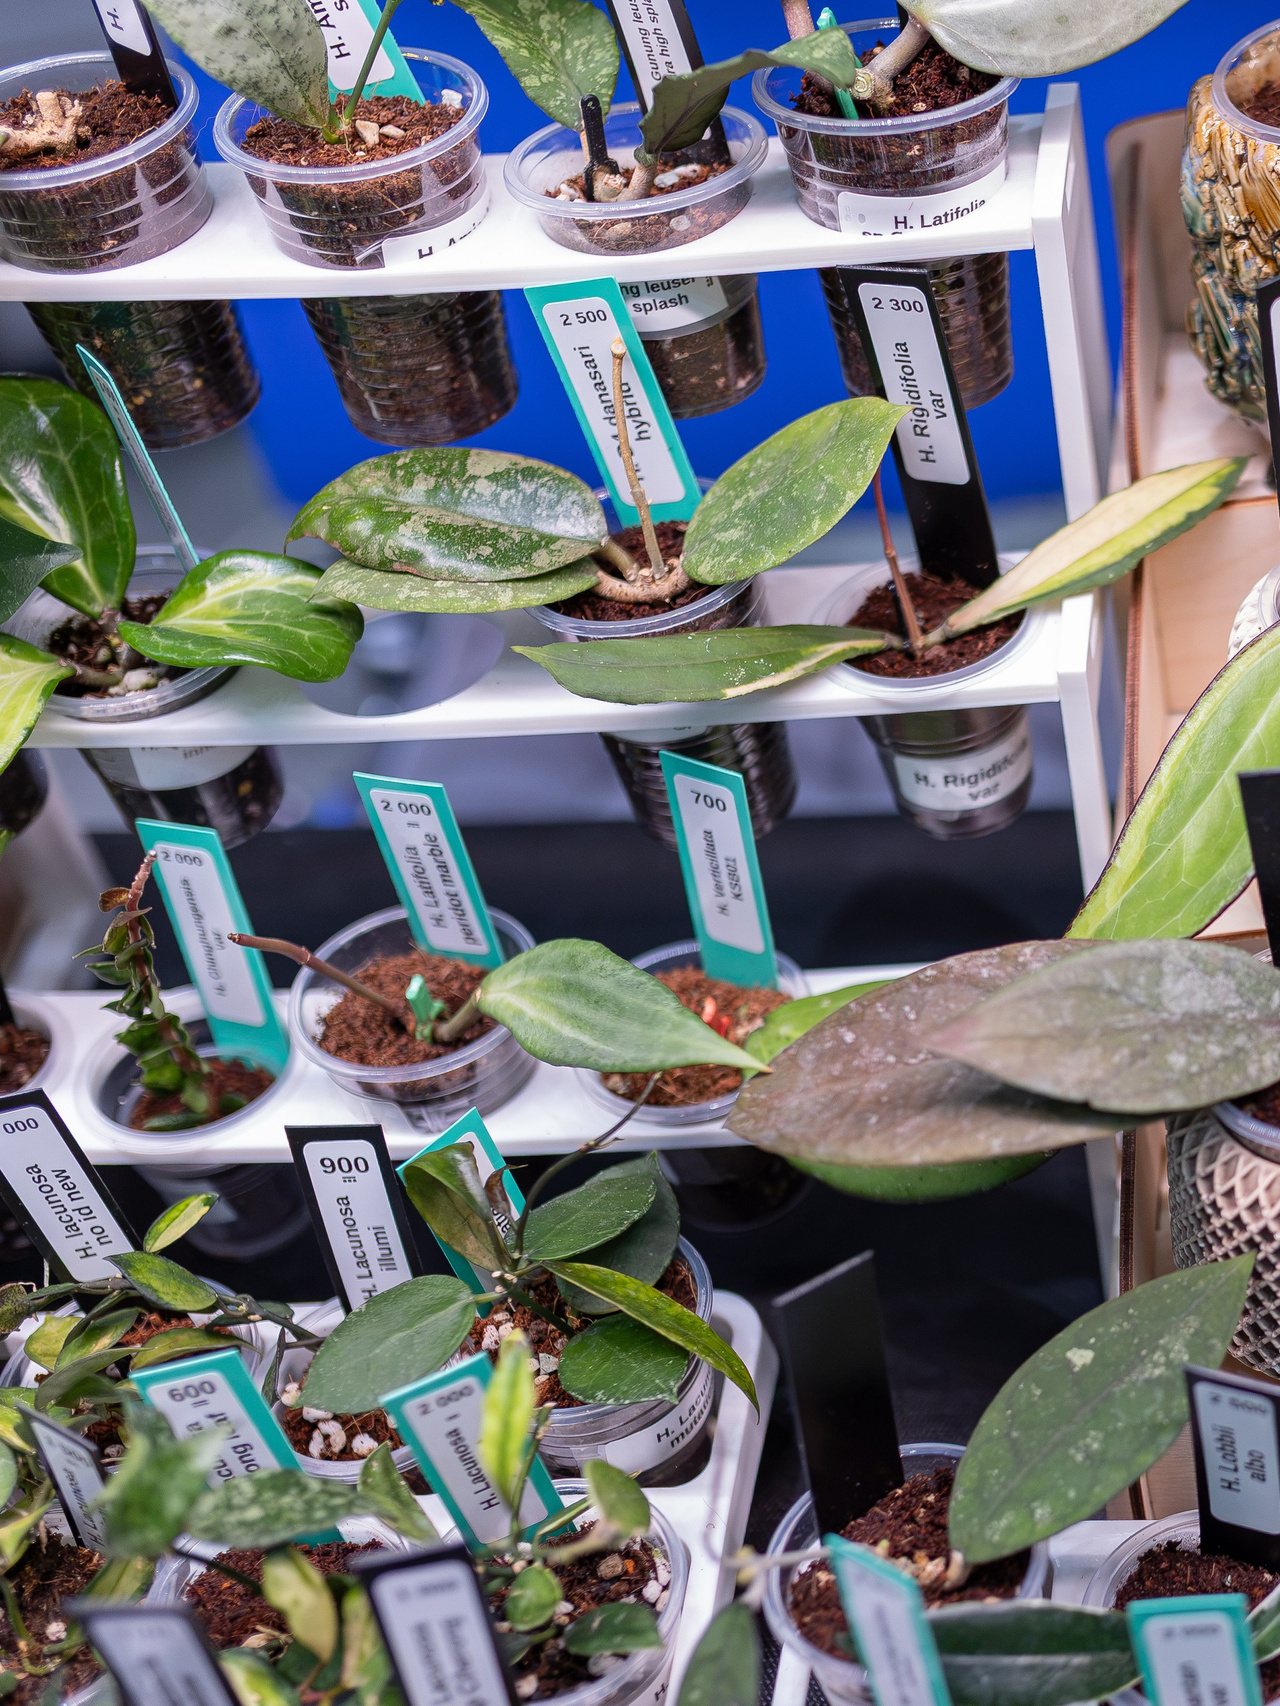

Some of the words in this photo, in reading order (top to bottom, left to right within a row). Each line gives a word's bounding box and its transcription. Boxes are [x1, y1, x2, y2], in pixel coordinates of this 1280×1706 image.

[652, 26, 671, 57] high
[638, 27, 662, 81] Gunung
[894, 215, 914, 229] H.
[632, 293, 690, 315] splash
[872, 297, 885, 310] 2
[890, 299, 924, 313] 300
[559, 313, 573, 326] 2
[575, 309, 608, 324] 500
[895, 341, 930, 438] Rigidifolia
[935, 390, 948, 419] var
[920, 444, 936, 464] H.
[380, 800, 393, 812] 2
[398, 802, 431, 816] 000
[690, 790, 727, 813] 700
[161, 851, 171, 862] 2
[175, 853, 203, 867] 000
[424, 832, 455, 888] marble
[703, 829, 726, 899] Verticillata
[404, 845, 440, 909] Latifolia
[444, 891, 484, 947] peridot
[2, 1117, 39, 1135] 000
[319, 1156, 369, 1174] 900
[51, 1168, 84, 1202] new
[25, 1163, 84, 1239] lacunosa
[72, 1205, 97, 1222] id
[90, 1224, 113, 1245] no
[336, 1195, 374, 1281] Lacunosa
[75, 1240, 98, 1260] H.
[167, 1381, 216, 1402] 600
[1212, 1424, 1238, 1473] Lobbii
[446, 1428, 491, 1495] Lacunosa
[1244, 1449, 1267, 1483] albo
[1220, 1477, 1241, 1493] H.
[479, 1491, 500, 1511] H.
